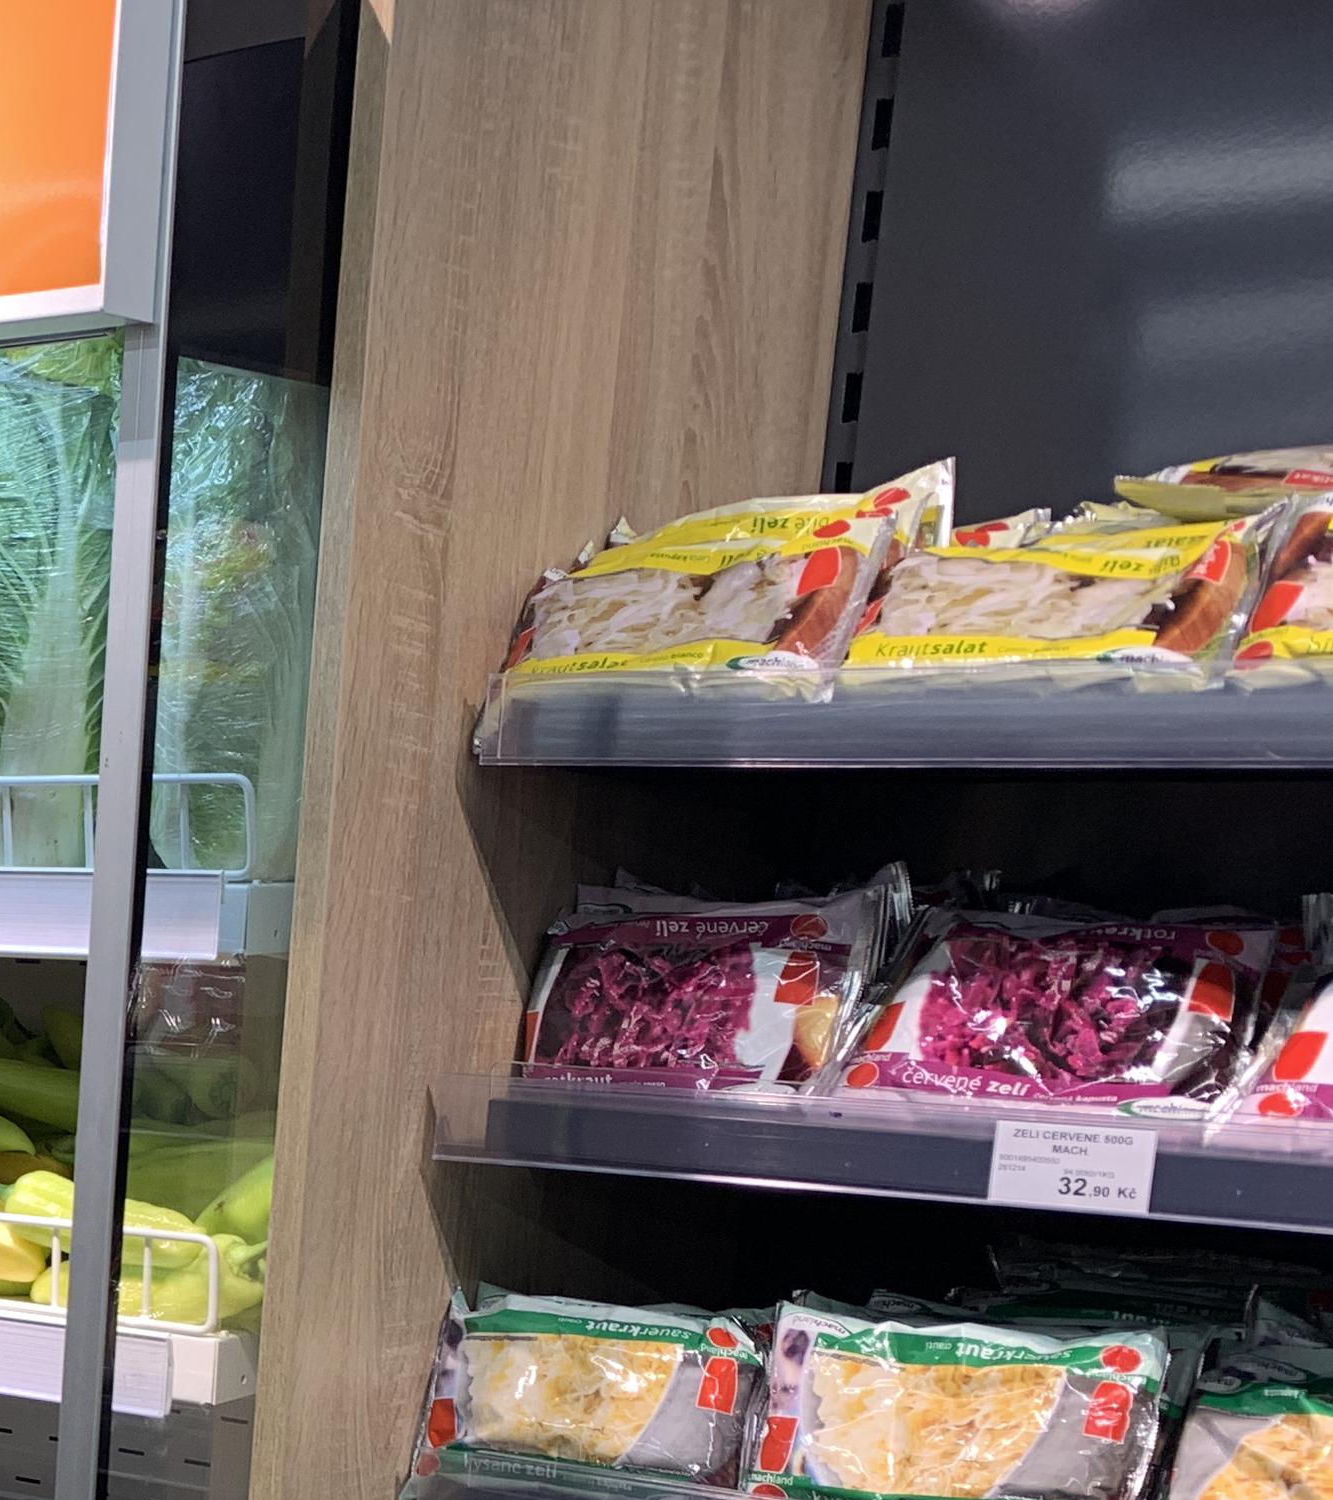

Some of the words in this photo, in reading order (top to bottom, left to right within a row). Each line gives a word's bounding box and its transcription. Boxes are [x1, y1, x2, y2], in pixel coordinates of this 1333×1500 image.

[656, 918, 688, 936] zelí
[695, 918, 769, 936] červené
[901, 1068, 982, 1094] červené
[987, 1078, 1028, 1097] zelí
[1013, 1128, 1039, 1139] ZELI
[1043, 1131, 1100, 1143] CERVENE
[1104, 1135, 1134, 1146] 500G
[1057, 1176, 1110, 1198] 32,90
[1117, 1186, 1137, 1200] Kč
[584, 1318, 692, 1340] sauerkraut
[956, 1340, 1072, 1360] sauerkraut
